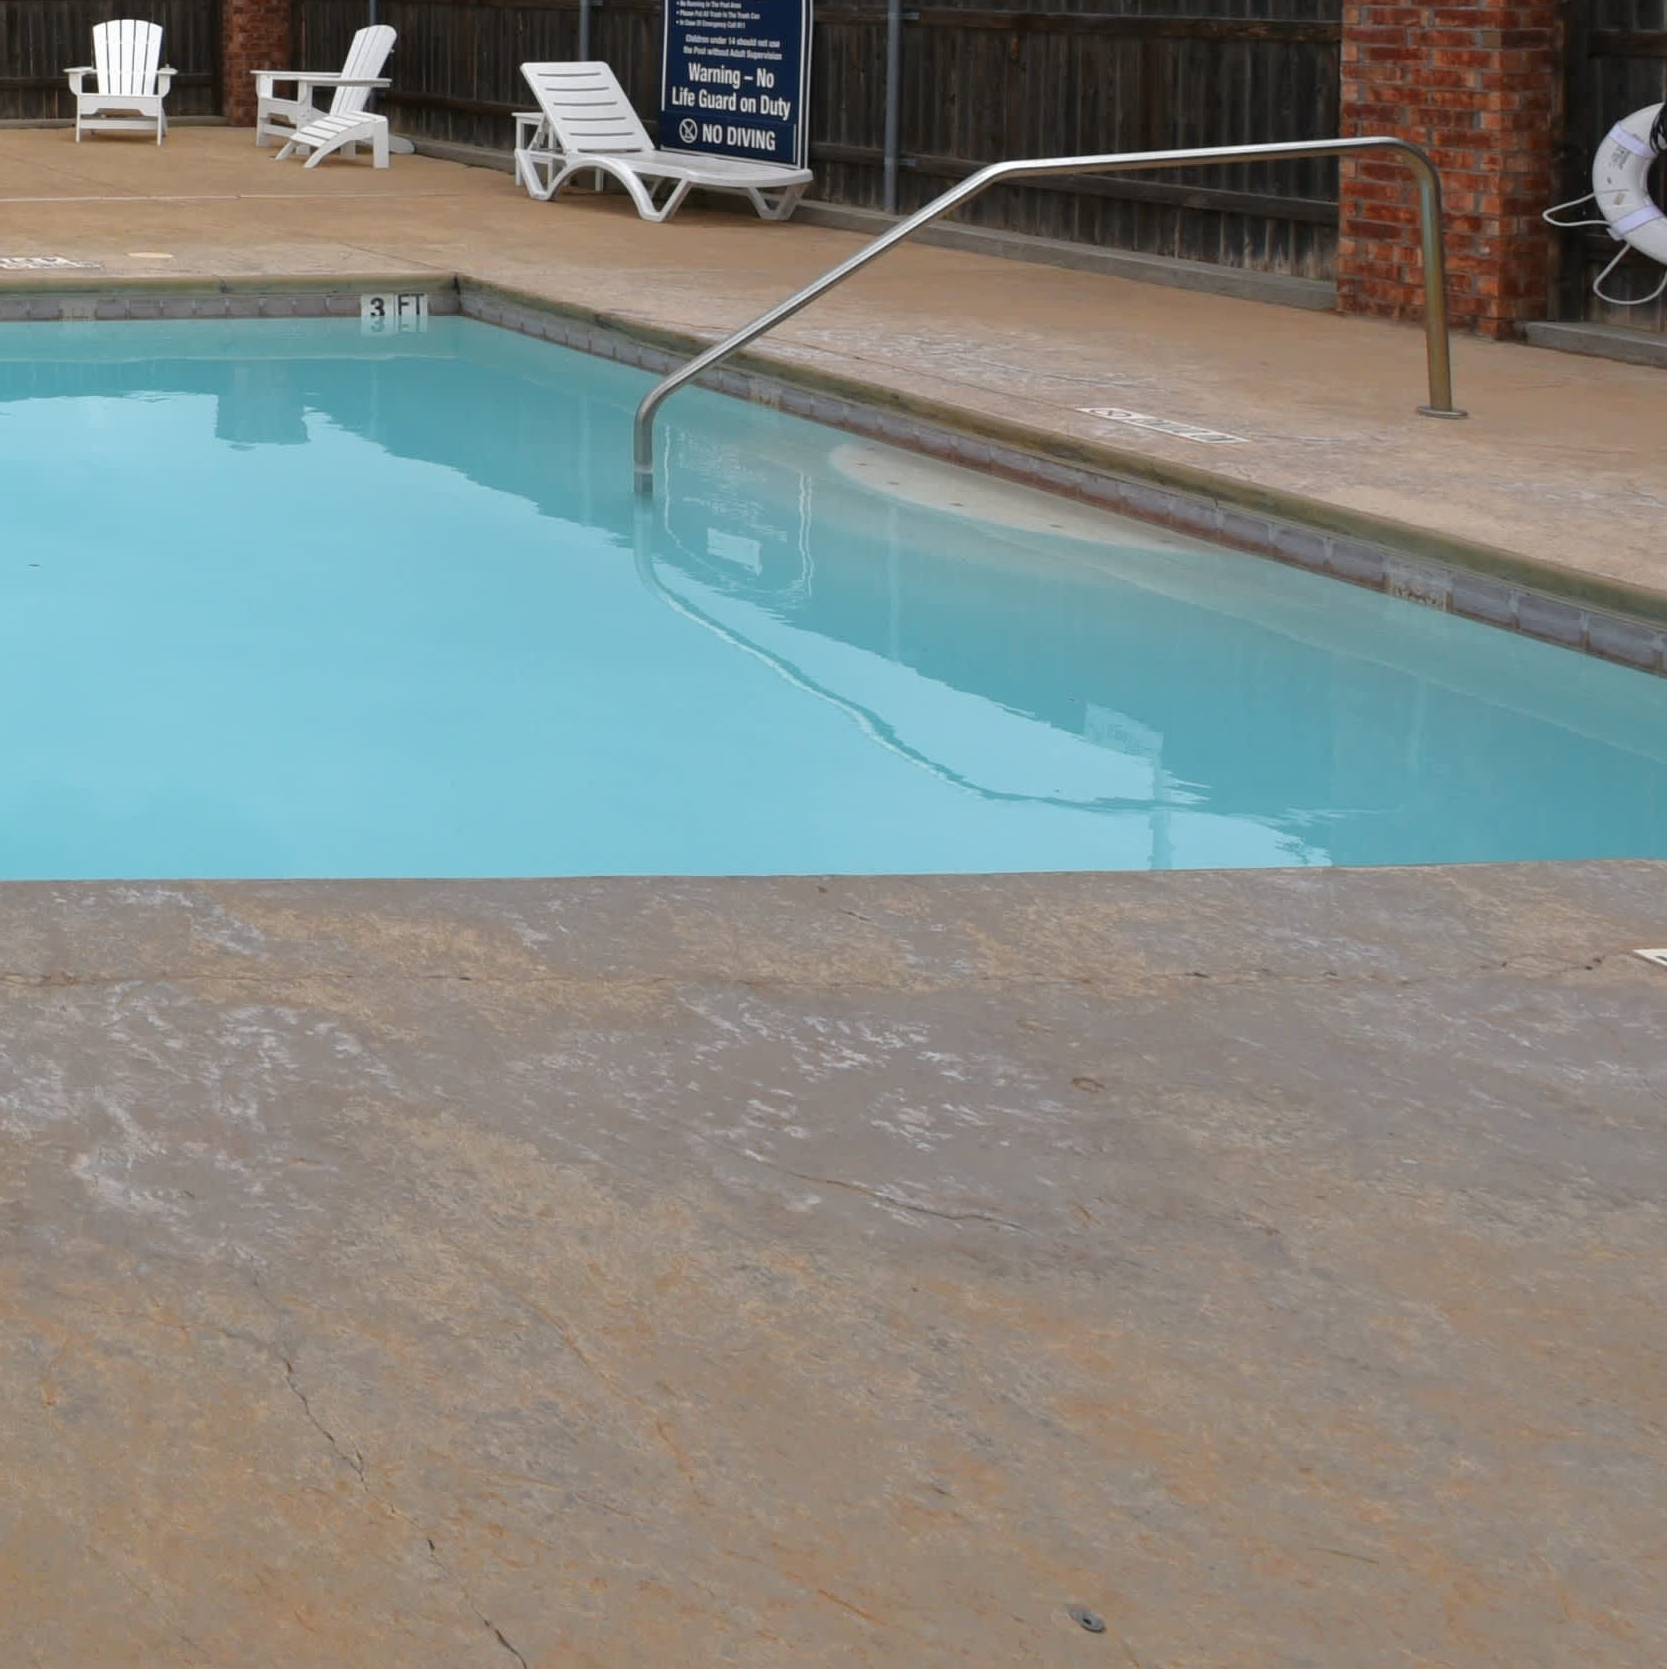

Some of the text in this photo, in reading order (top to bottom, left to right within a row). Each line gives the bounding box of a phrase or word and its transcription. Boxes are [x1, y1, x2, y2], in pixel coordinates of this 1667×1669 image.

[688, 62, 741, 89] Warning
[756, 68, 774, 88] No
[672, 86, 791, 121] Life Guard on Duty
[702, 123, 776, 151] NO DIVING
[370, 293, 425, 317] 3 FT
